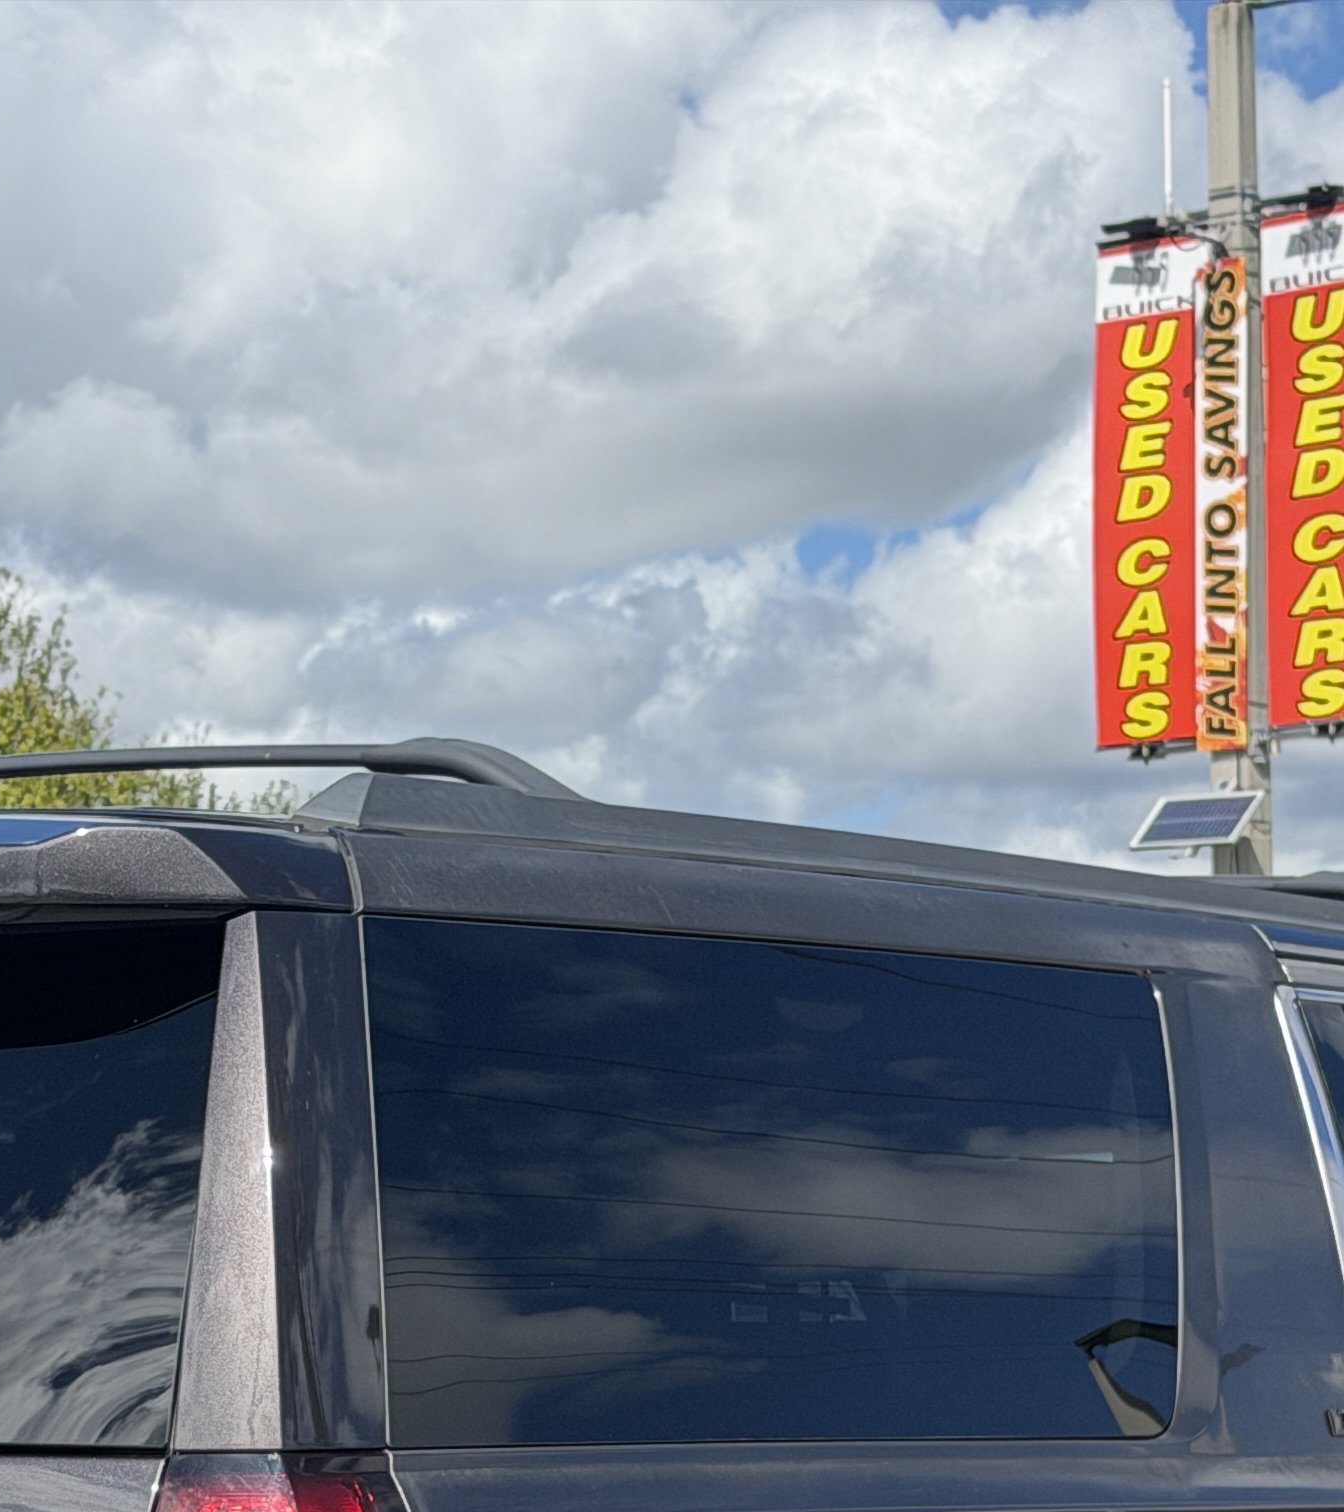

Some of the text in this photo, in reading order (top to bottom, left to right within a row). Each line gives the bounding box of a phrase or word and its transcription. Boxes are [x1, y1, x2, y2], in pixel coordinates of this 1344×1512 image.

[1113, 318, 1179, 740] USED CARS
[1205, 270, 1238, 738] FALL INTO SAVINGS
